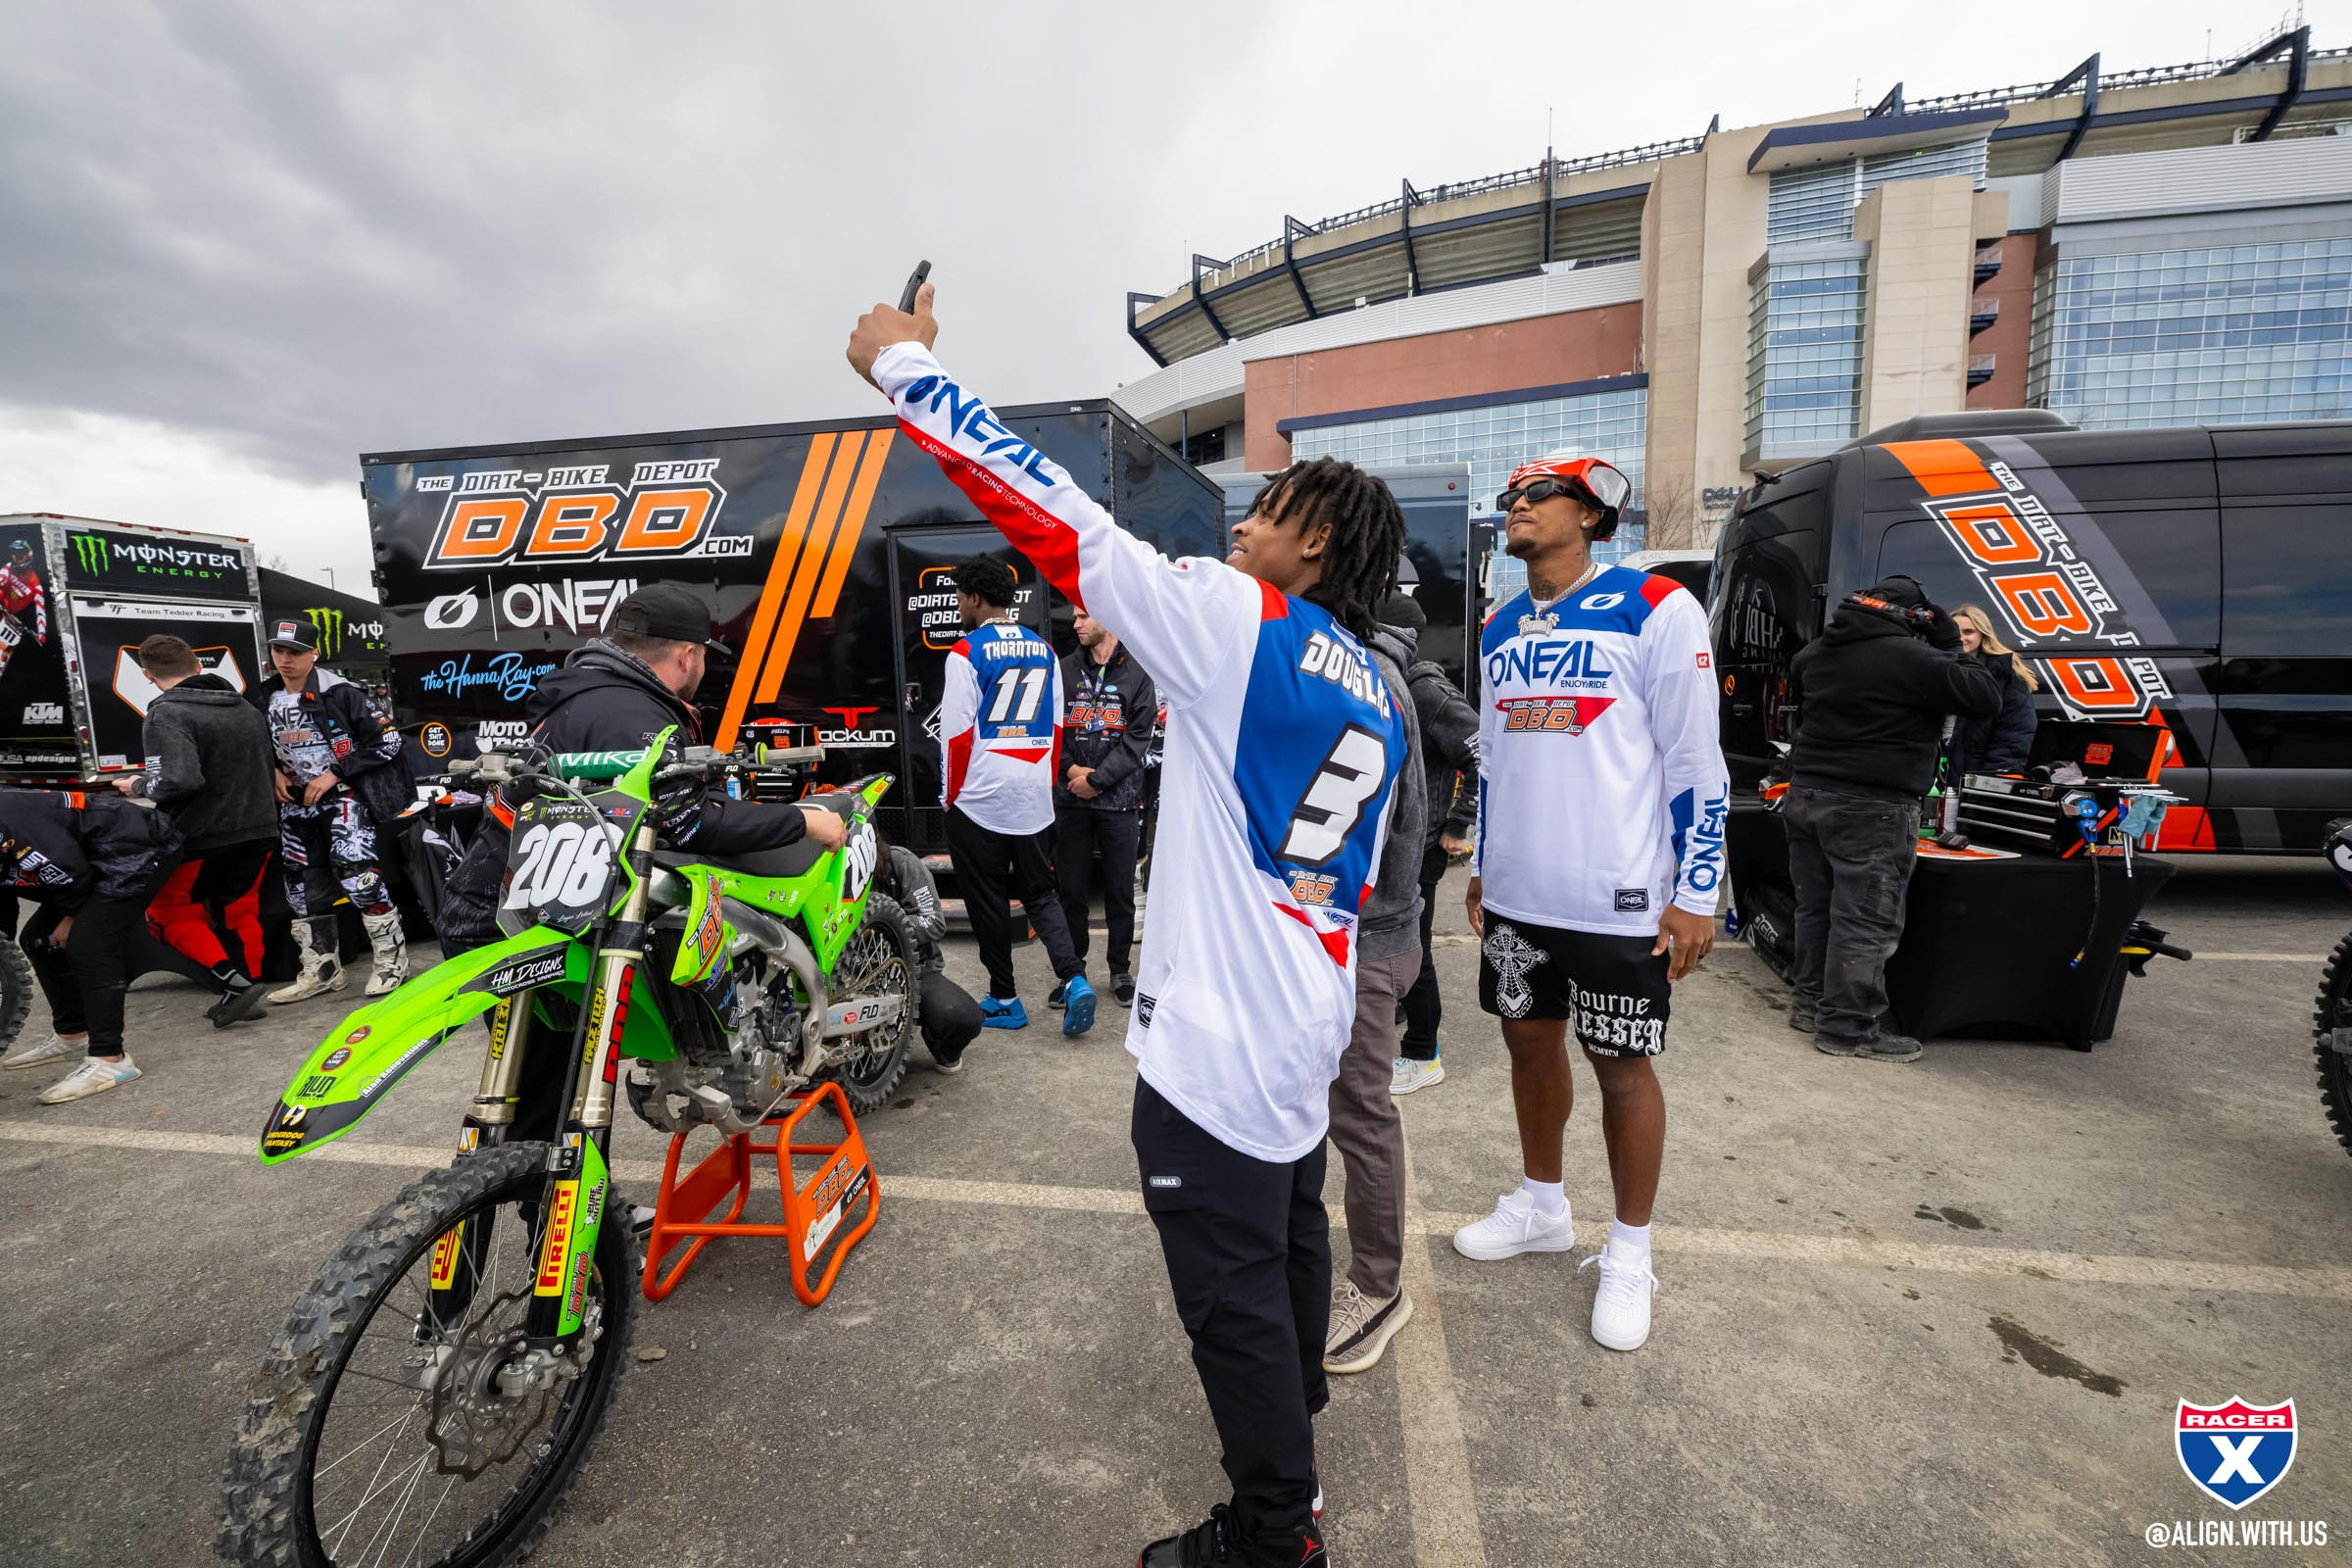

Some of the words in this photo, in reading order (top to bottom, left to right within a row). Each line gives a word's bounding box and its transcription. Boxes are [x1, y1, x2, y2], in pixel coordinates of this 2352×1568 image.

[420, 477, 451, 489] THE
[636, 462, 716, 482] DEPOT
[927, 443, 972, 470] ADVANCED
[971, 467, 1003, 494] RACING
[1002, 490, 1057, 529] TECHNOLOGY
[1991, 463, 2023, 490] THE
[437, 488, 714, 559] DBD
[113, 544, 239, 569] MONSTER
[136, 565, 223, 579] ENERGY
[1938, 503, 2137, 707] DBD
[983, 640, 1048, 661] THORNTON
[987, 666, 1050, 723] 11
[24, 703, 64, 720] KTM
[1509, 709, 1575, 729] DBD
[478, 721, 527, 737] MOTO
[817, 728, 896, 743] ackum
[24, 753, 76, 764] apdesigns
[1276, 722, 1388, 866] 3
[502, 821, 624, 909] 208
[846, 823, 877, 902] 208
[491, 966, 514, 987] HM
[516, 956, 564, 980] DESIGNS
[497, 979, 536, 994] MOTOCROSS
[537, 969, 565, 982] GRAPHICS
[584, 1027, 599, 1064] RACE
[592, 988, 606, 1025] TECH
[539, 1188, 572, 1287] PIRELLI
